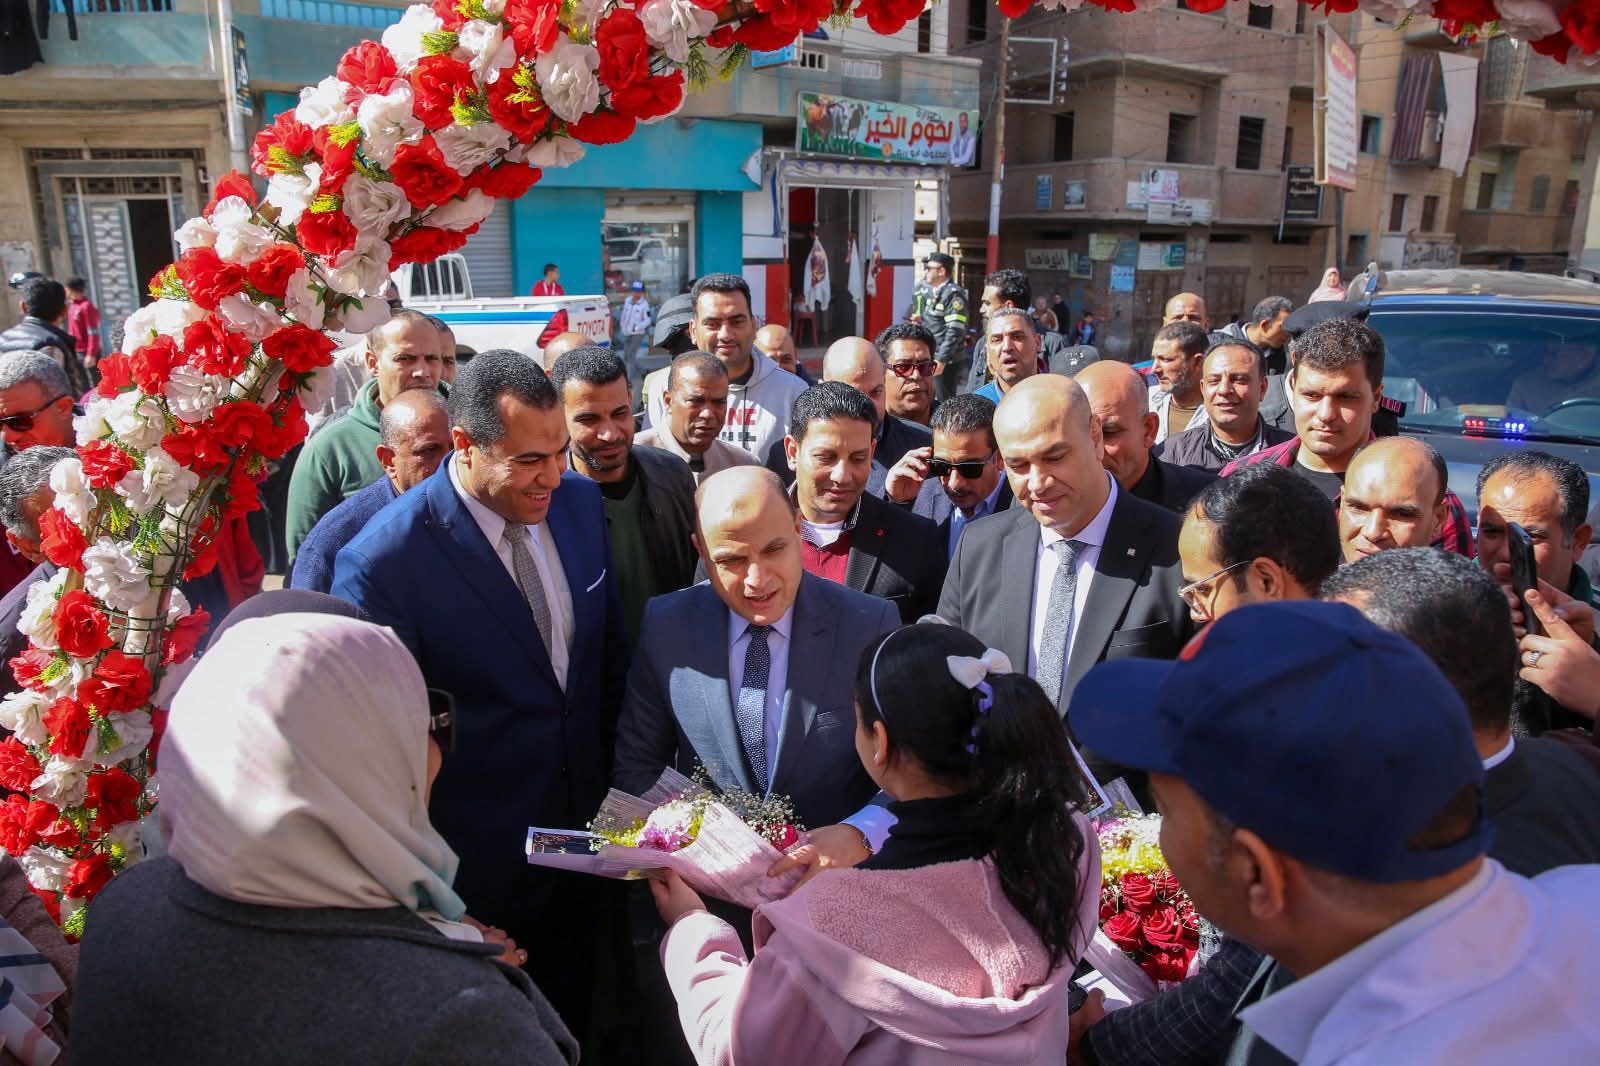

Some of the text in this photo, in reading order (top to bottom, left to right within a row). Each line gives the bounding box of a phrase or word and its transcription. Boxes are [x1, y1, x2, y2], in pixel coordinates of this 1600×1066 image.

[864, 112, 953, 148] لحوم الخير
[577, 319, 606, 337] TOYOTA
